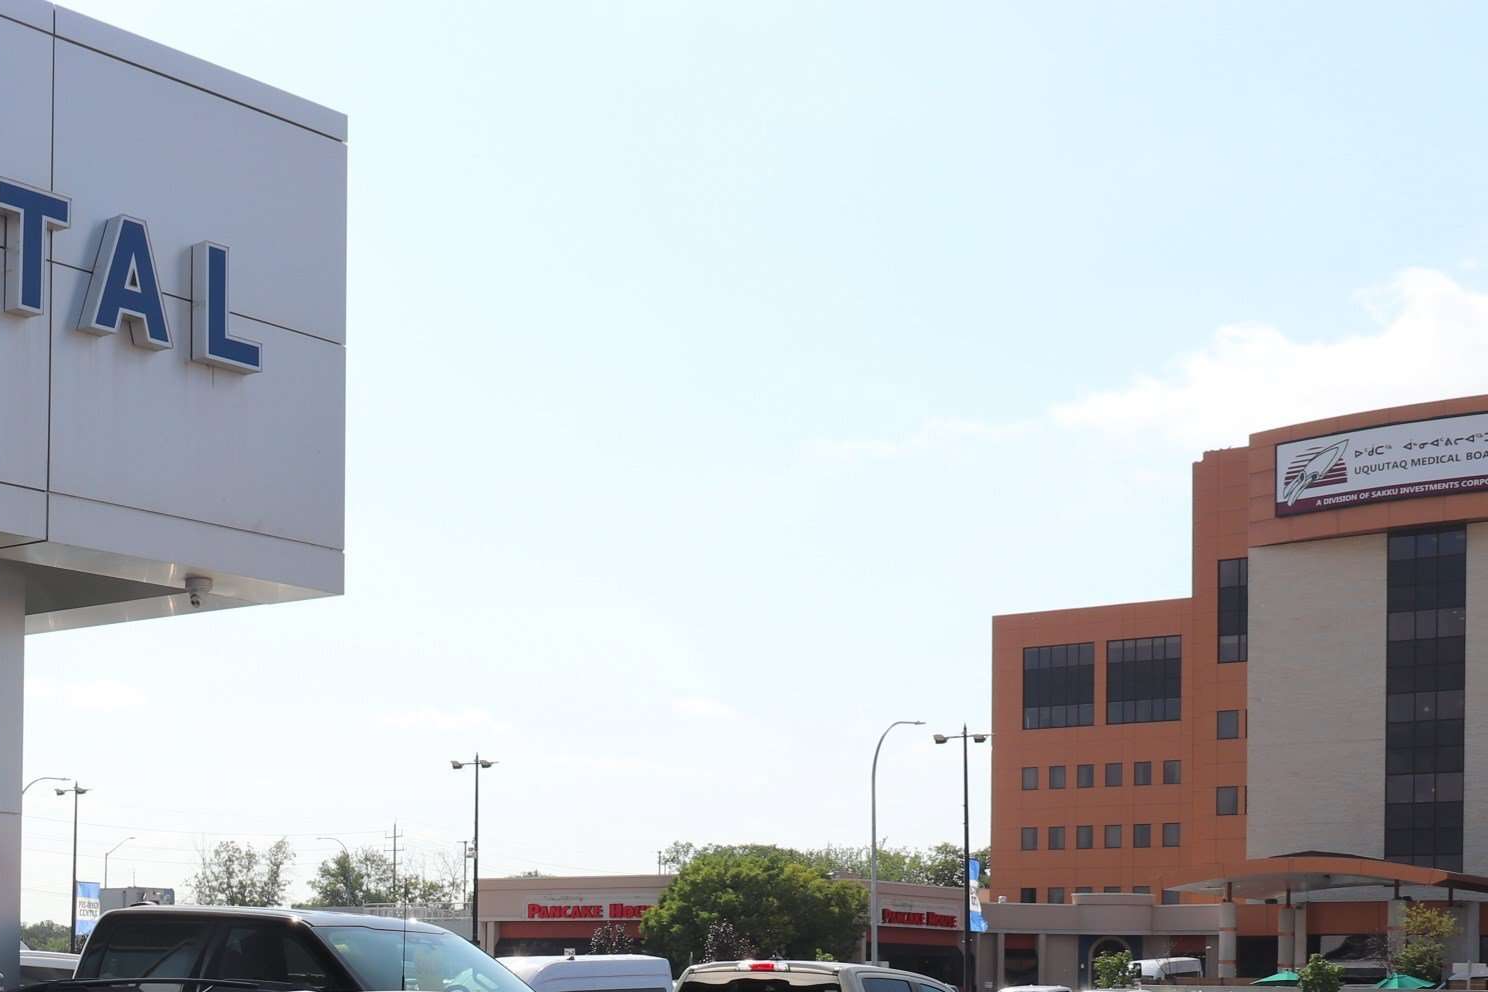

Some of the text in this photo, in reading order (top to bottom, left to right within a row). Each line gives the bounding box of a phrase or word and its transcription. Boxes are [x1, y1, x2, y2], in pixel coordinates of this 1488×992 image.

[1354, 459, 1408, 475] UQUUTAQ
[1411, 453, 1461, 467] MEDICAL
[1316, 499, 1322, 507] A
[1323, 493, 1358, 506] DIVISION
[1359, 492, 1371, 500] OF
[1371, 487, 1398, 498] SAKKU
[1400, 481, 1459, 494] INVESTMENTS
[527, 903, 604, 919] PANCAKE
